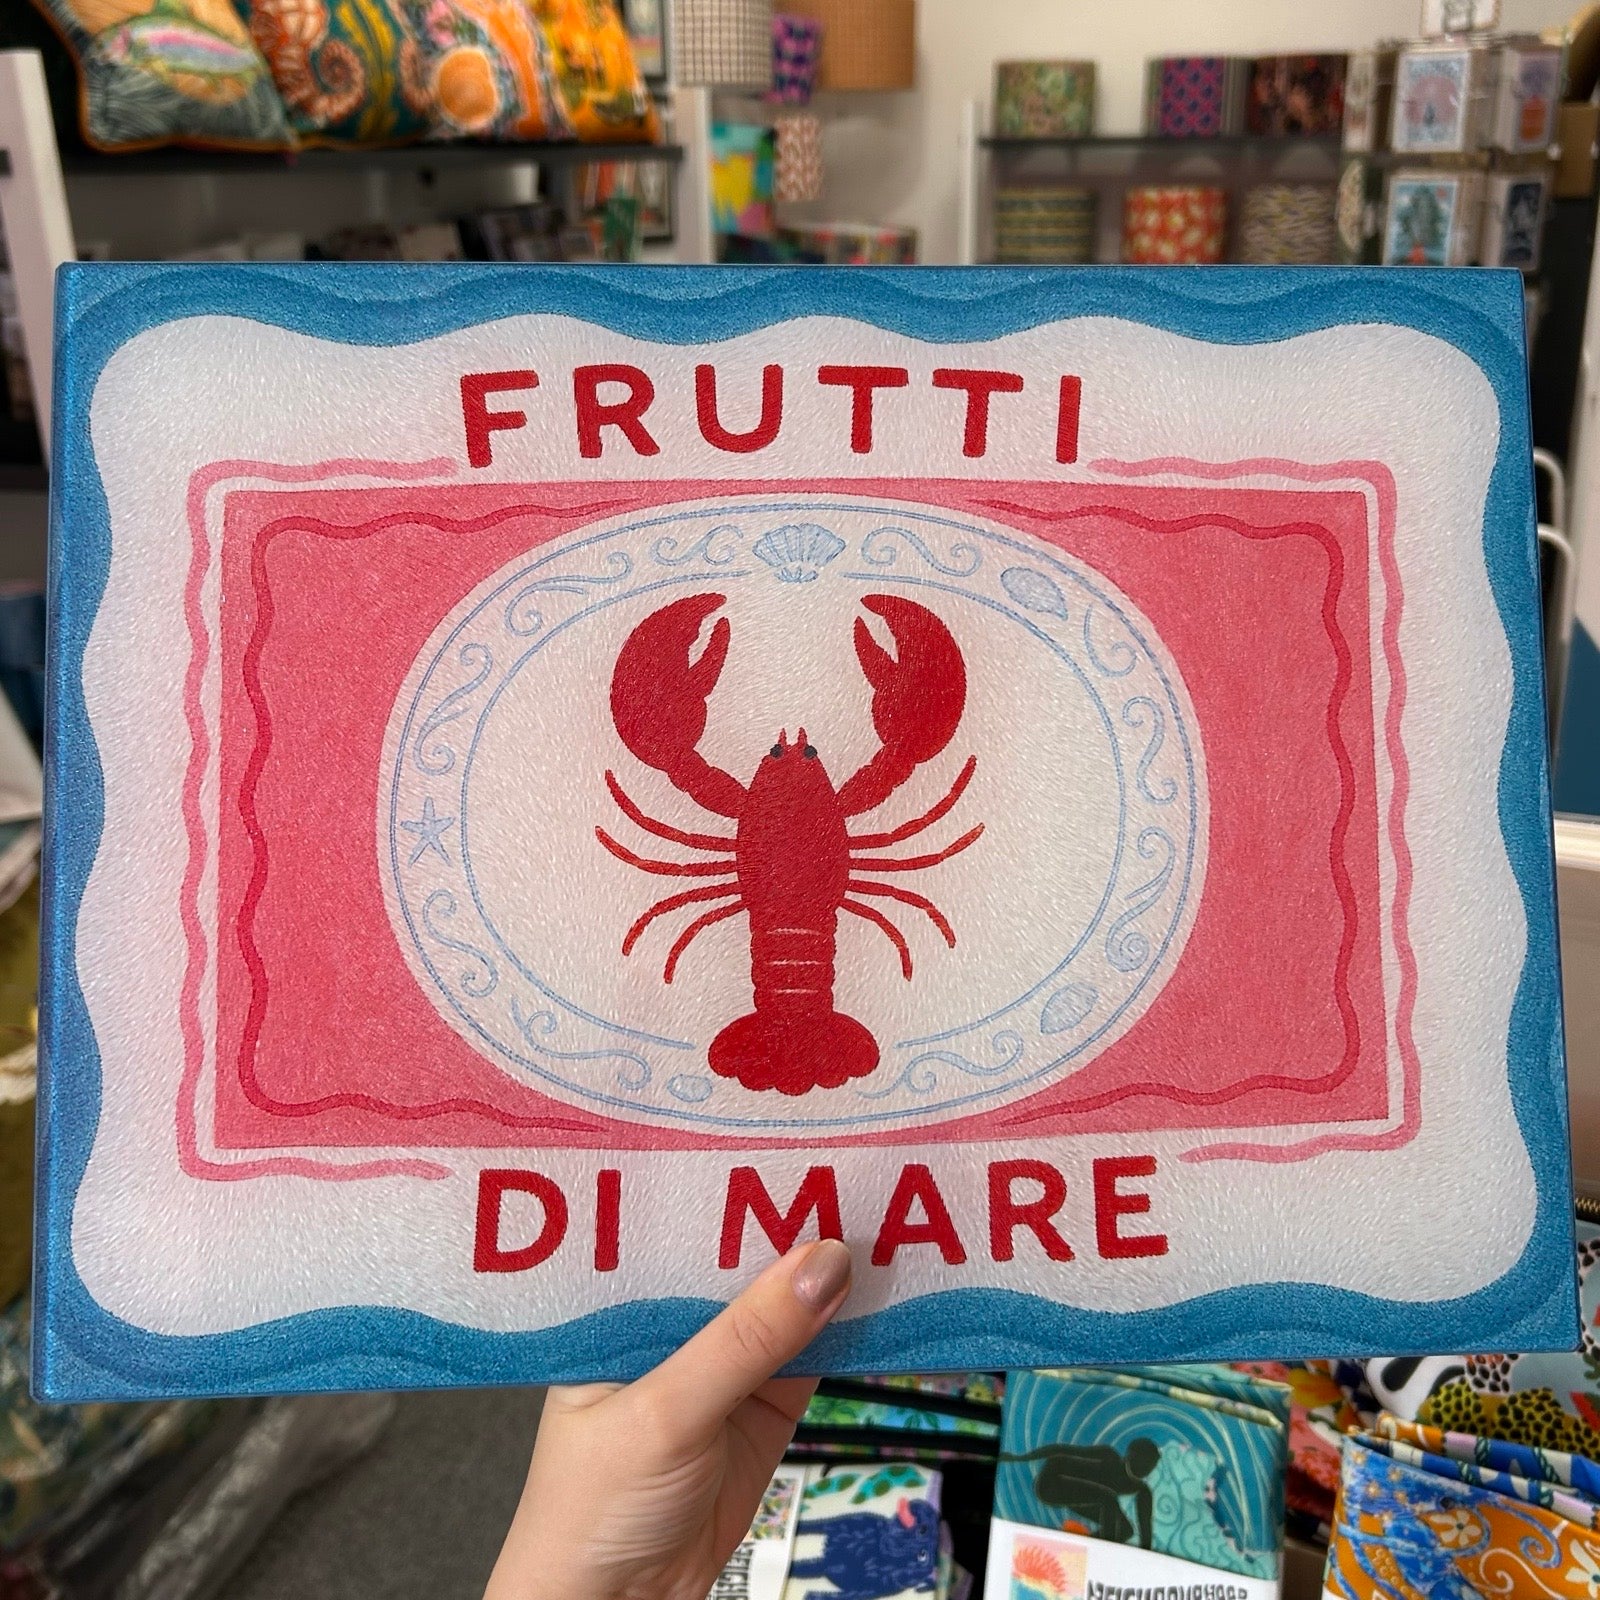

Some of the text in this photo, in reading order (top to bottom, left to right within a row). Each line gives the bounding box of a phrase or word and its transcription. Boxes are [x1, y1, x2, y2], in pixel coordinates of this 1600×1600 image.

[460, 363, 1083, 469] FRUTTI
[473, 1154, 1169, 1274] DI MARE
